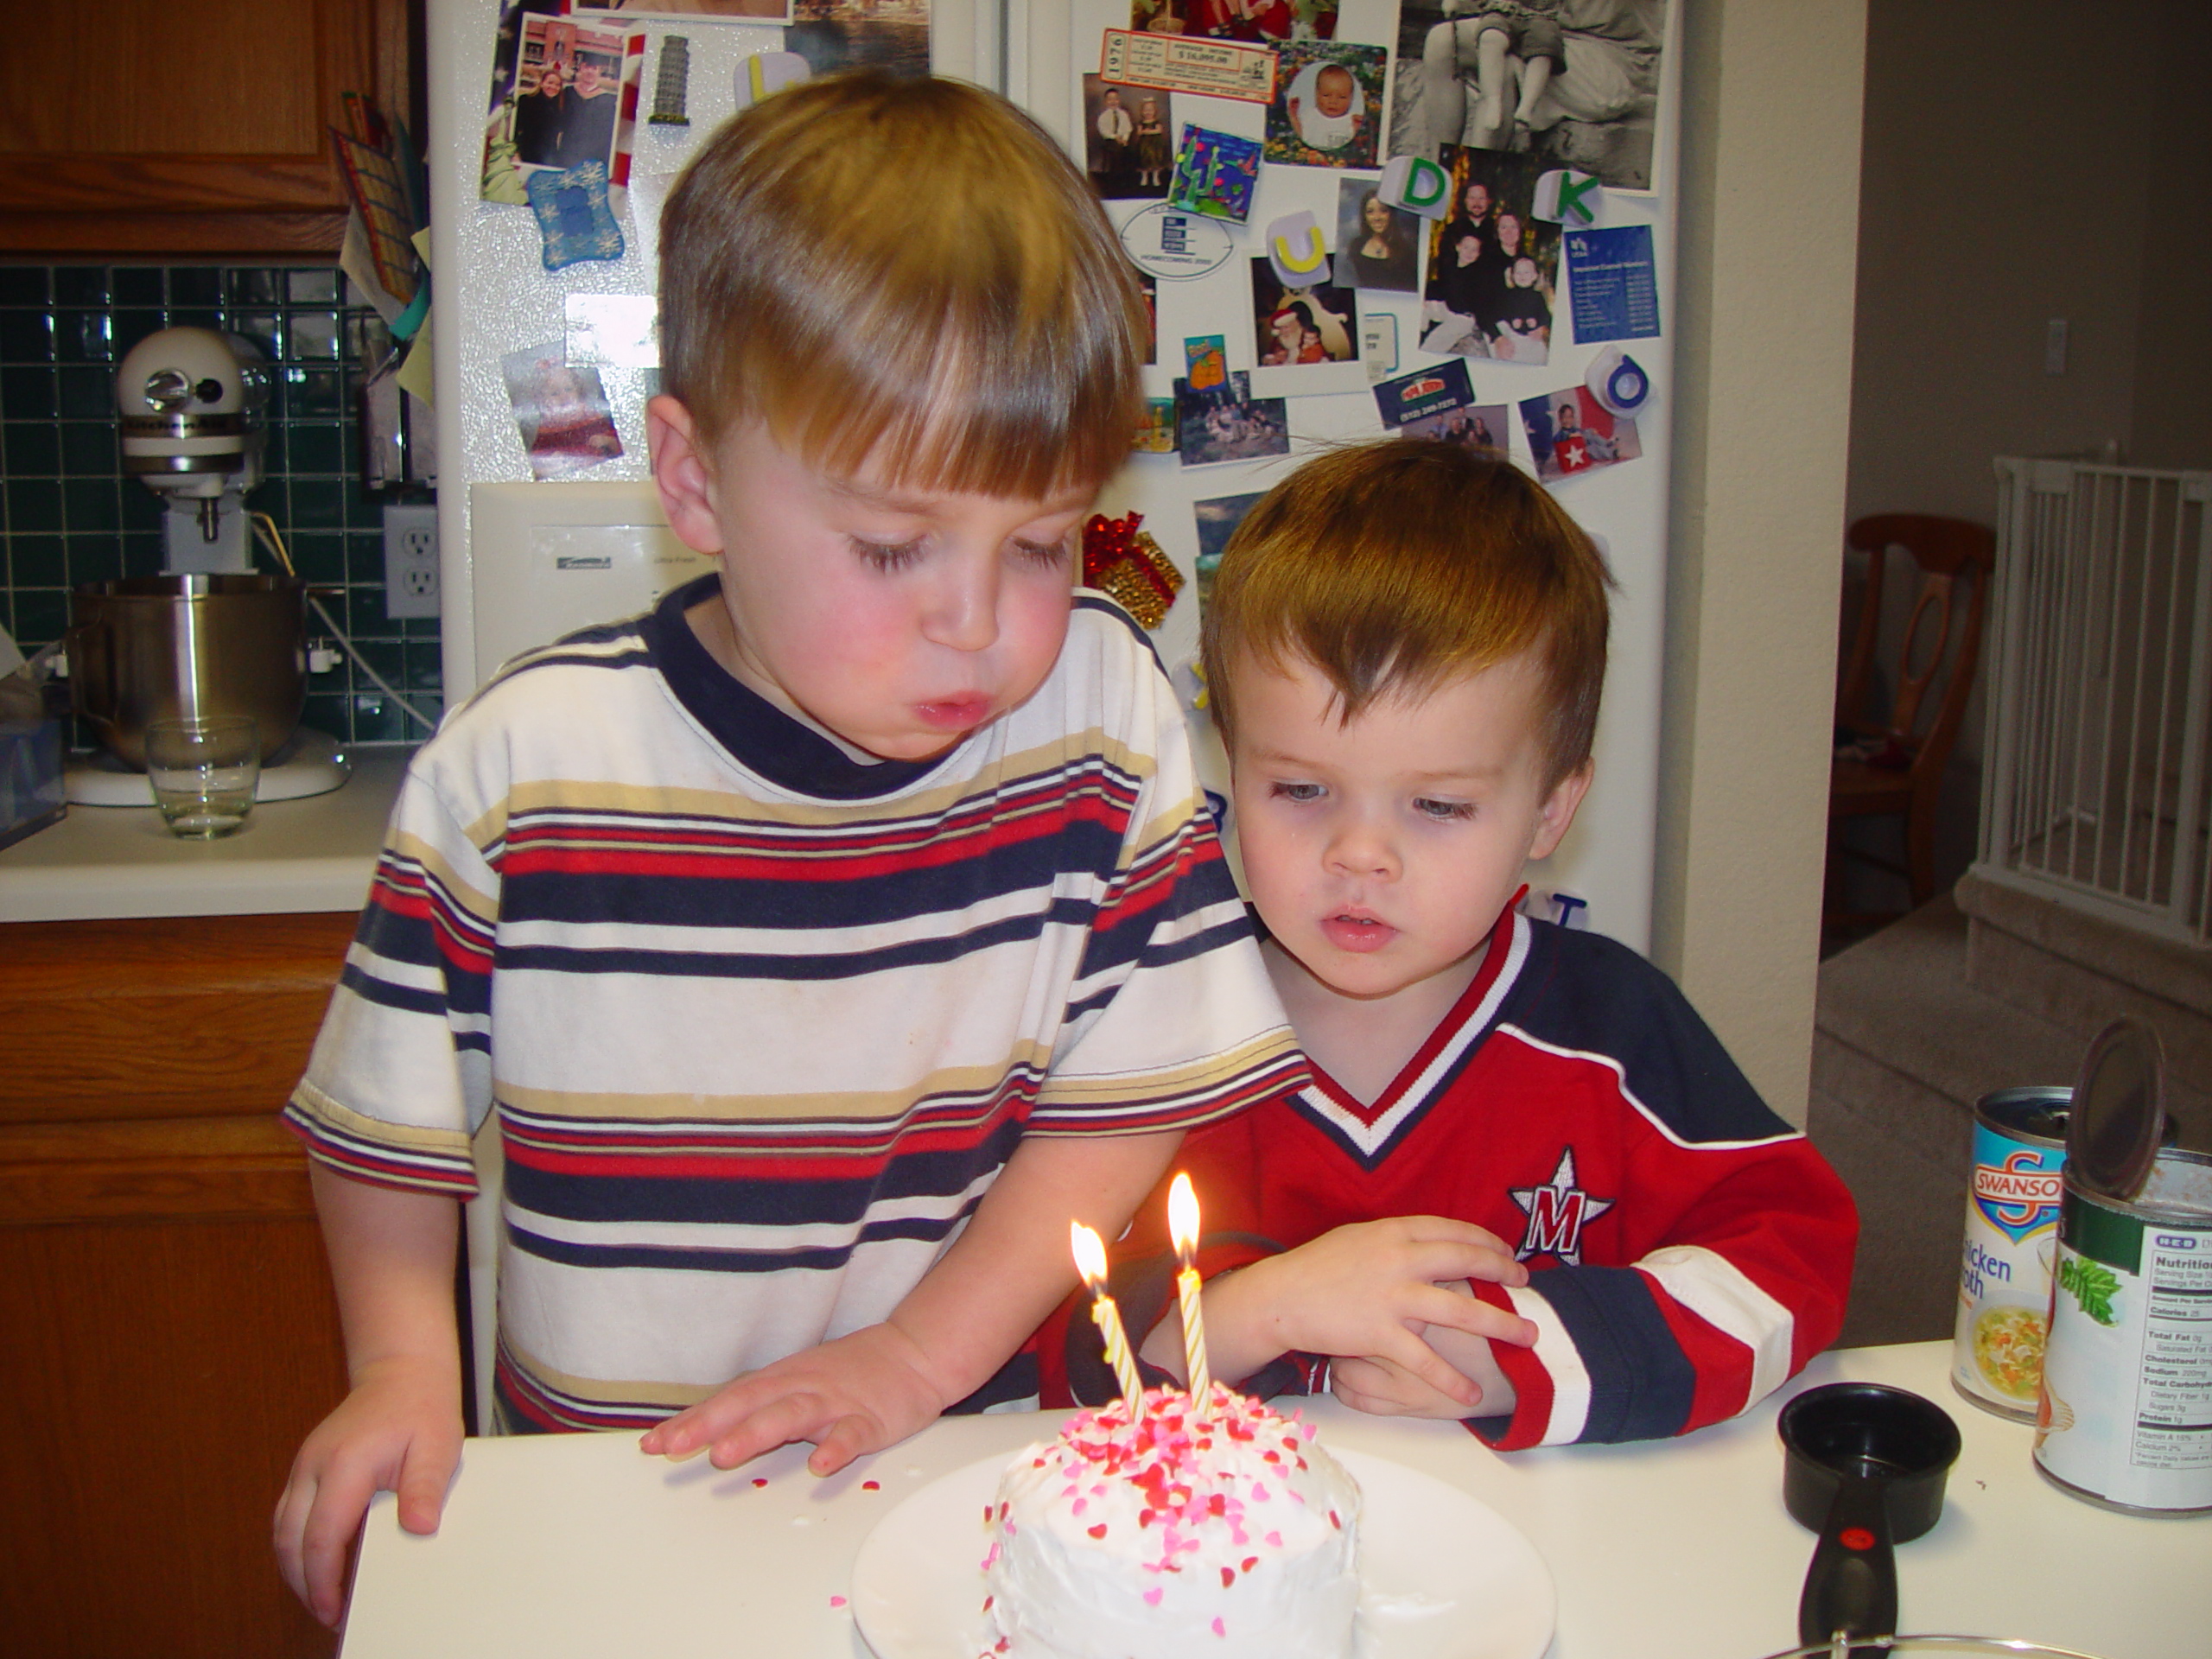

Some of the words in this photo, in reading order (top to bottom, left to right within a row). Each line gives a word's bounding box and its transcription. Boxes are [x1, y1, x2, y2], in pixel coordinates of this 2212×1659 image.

[1403, 157, 1446, 207] D
[1558, 171, 1599, 223] K
[1977, 1173, 2060, 1197] SWANSO
[1526, 1185, 1586, 1253] M
[2150, 1306, 2188, 1317] Calories
[2148, 1331, 2172, 1340] Total
[2145, 1354, 2197, 1364] Cholesterol
[2144, 1366, 2178, 1376] Sodium
[2143, 1377, 2167, 1387] Total
[2169, 1380, 2212, 1389] Carbohyd
[2139, 1412, 2171, 1422] Protein
[2137, 1431, 2165, 1440] Vitamin
[2135, 1441, 2167, 1451] Calcium
